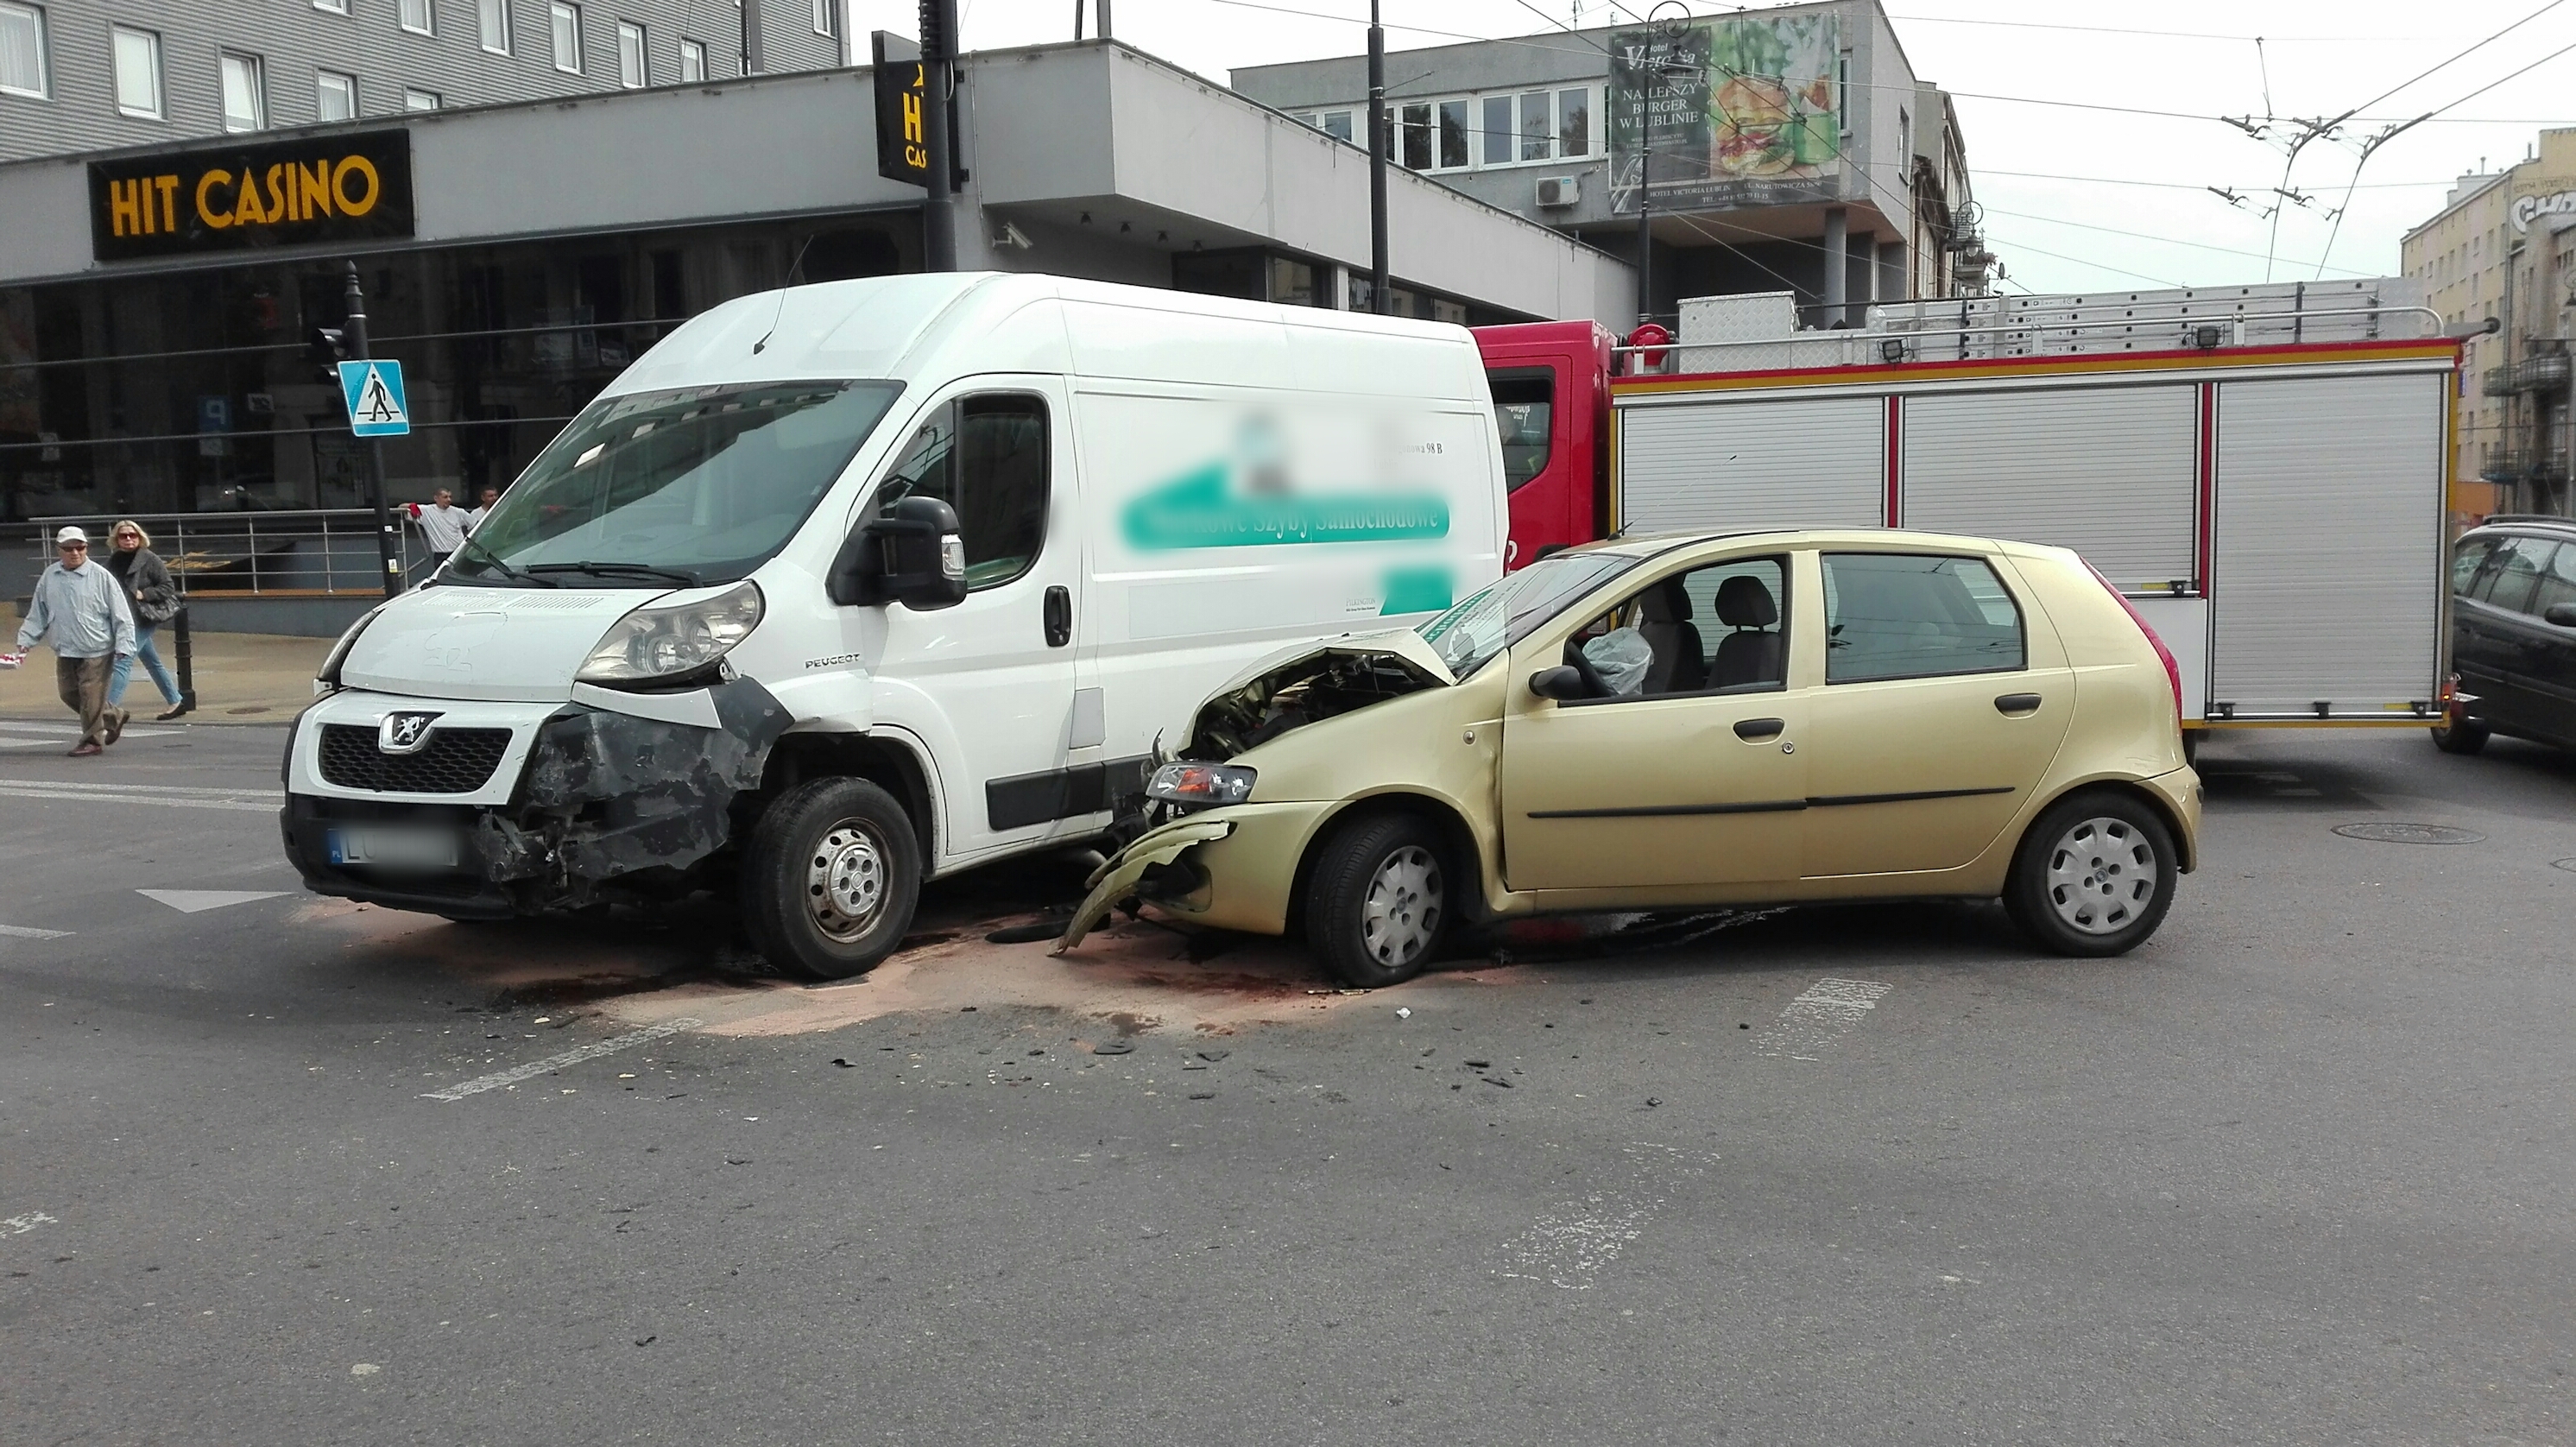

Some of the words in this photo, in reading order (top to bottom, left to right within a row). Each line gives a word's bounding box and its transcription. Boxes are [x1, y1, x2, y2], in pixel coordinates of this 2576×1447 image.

[1623, 83, 1698, 100] NALEPSZY
[1633, 98, 1687, 114] BURGER
[1619, 117, 1632, 129] W
[110, 174, 179, 237] HIT
[195, 155, 380, 229] CASINO
[1706, 185, 1731, 193] LUBLIN
[1426, 442, 1436, 454] 98
[1436, 443, 1443, 454] B
[805, 654, 861, 669] PEUGEOT
